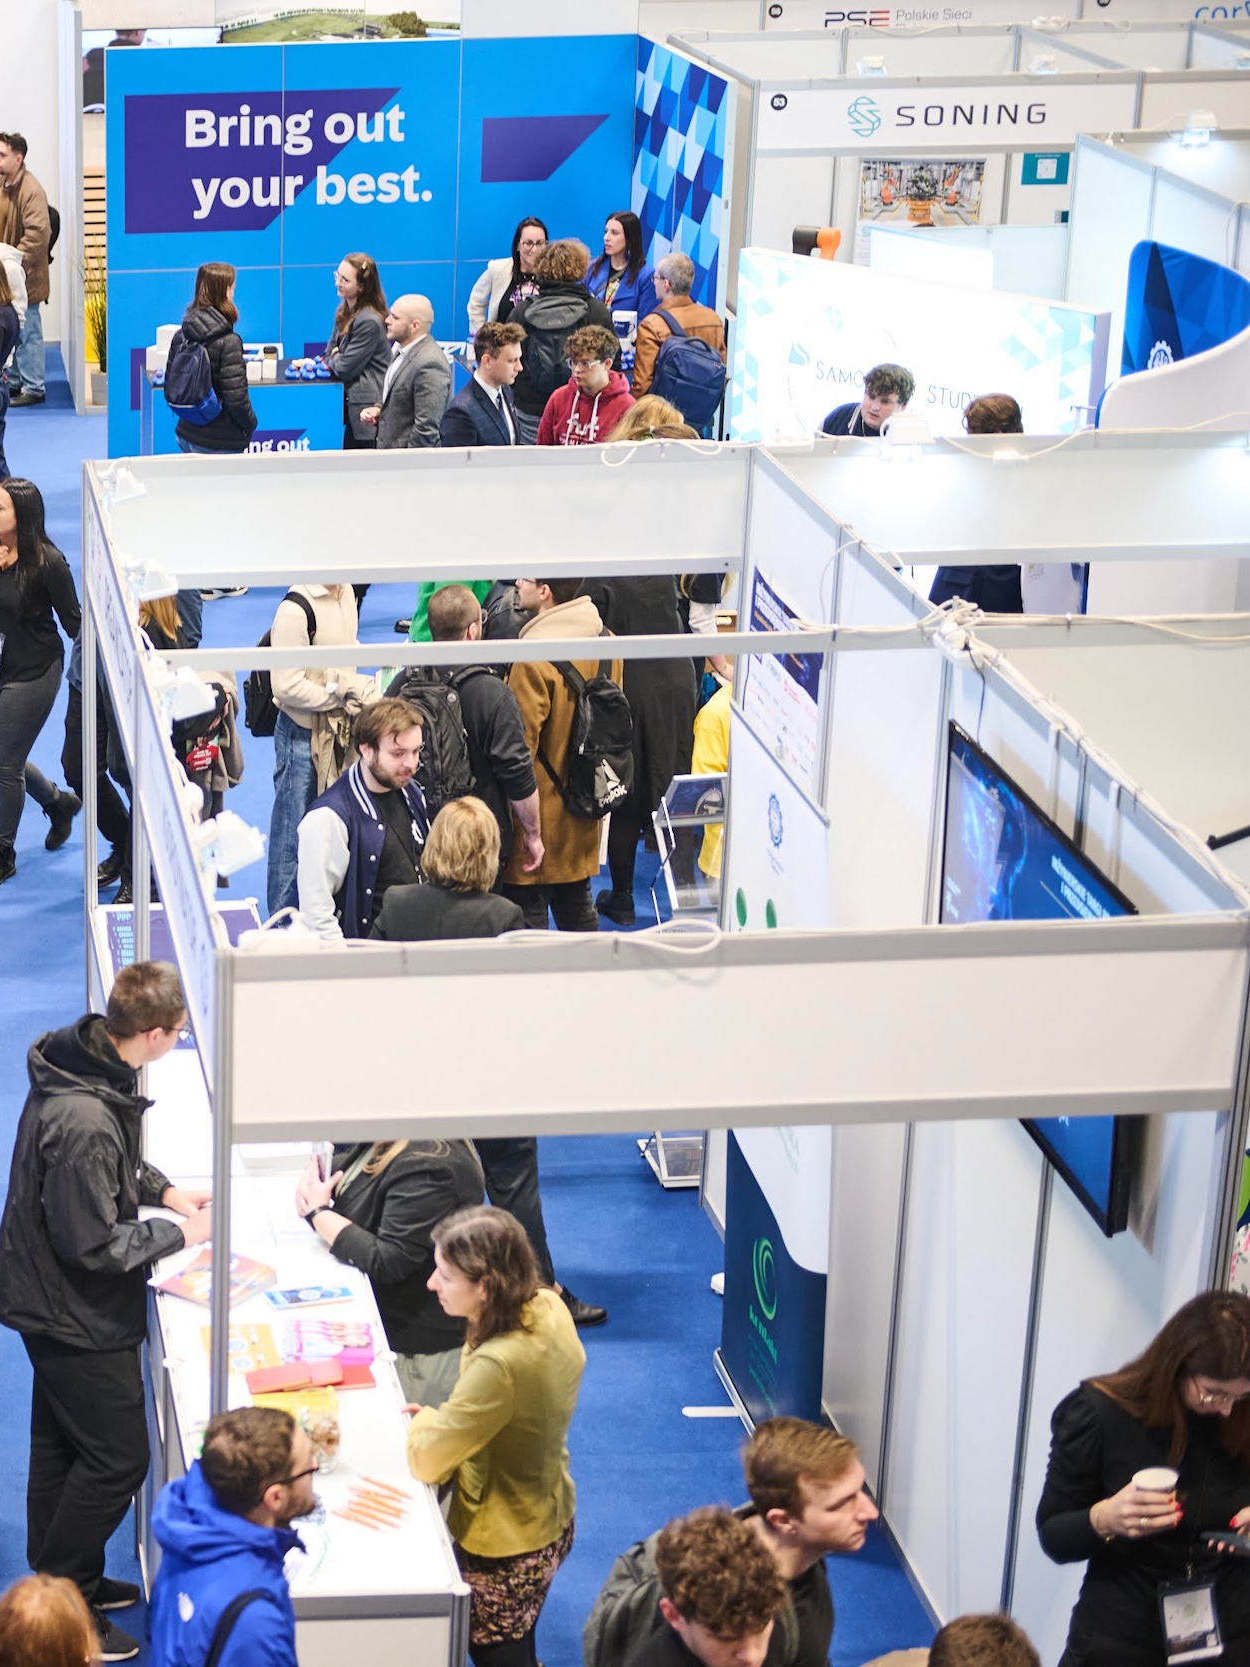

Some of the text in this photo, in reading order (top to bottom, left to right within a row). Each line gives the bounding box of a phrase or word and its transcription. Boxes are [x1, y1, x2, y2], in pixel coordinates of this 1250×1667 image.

[825, 10, 890, 28] PSE
[896, 8, 972, 22] Polskie Sieci
[1195, 1, 1250, 19] cor
[896, 103, 1047, 127] SONING
[185, 103, 405, 156] Bring out
[191, 164, 433, 220] your best.
[276, 436, 310, 453] out
